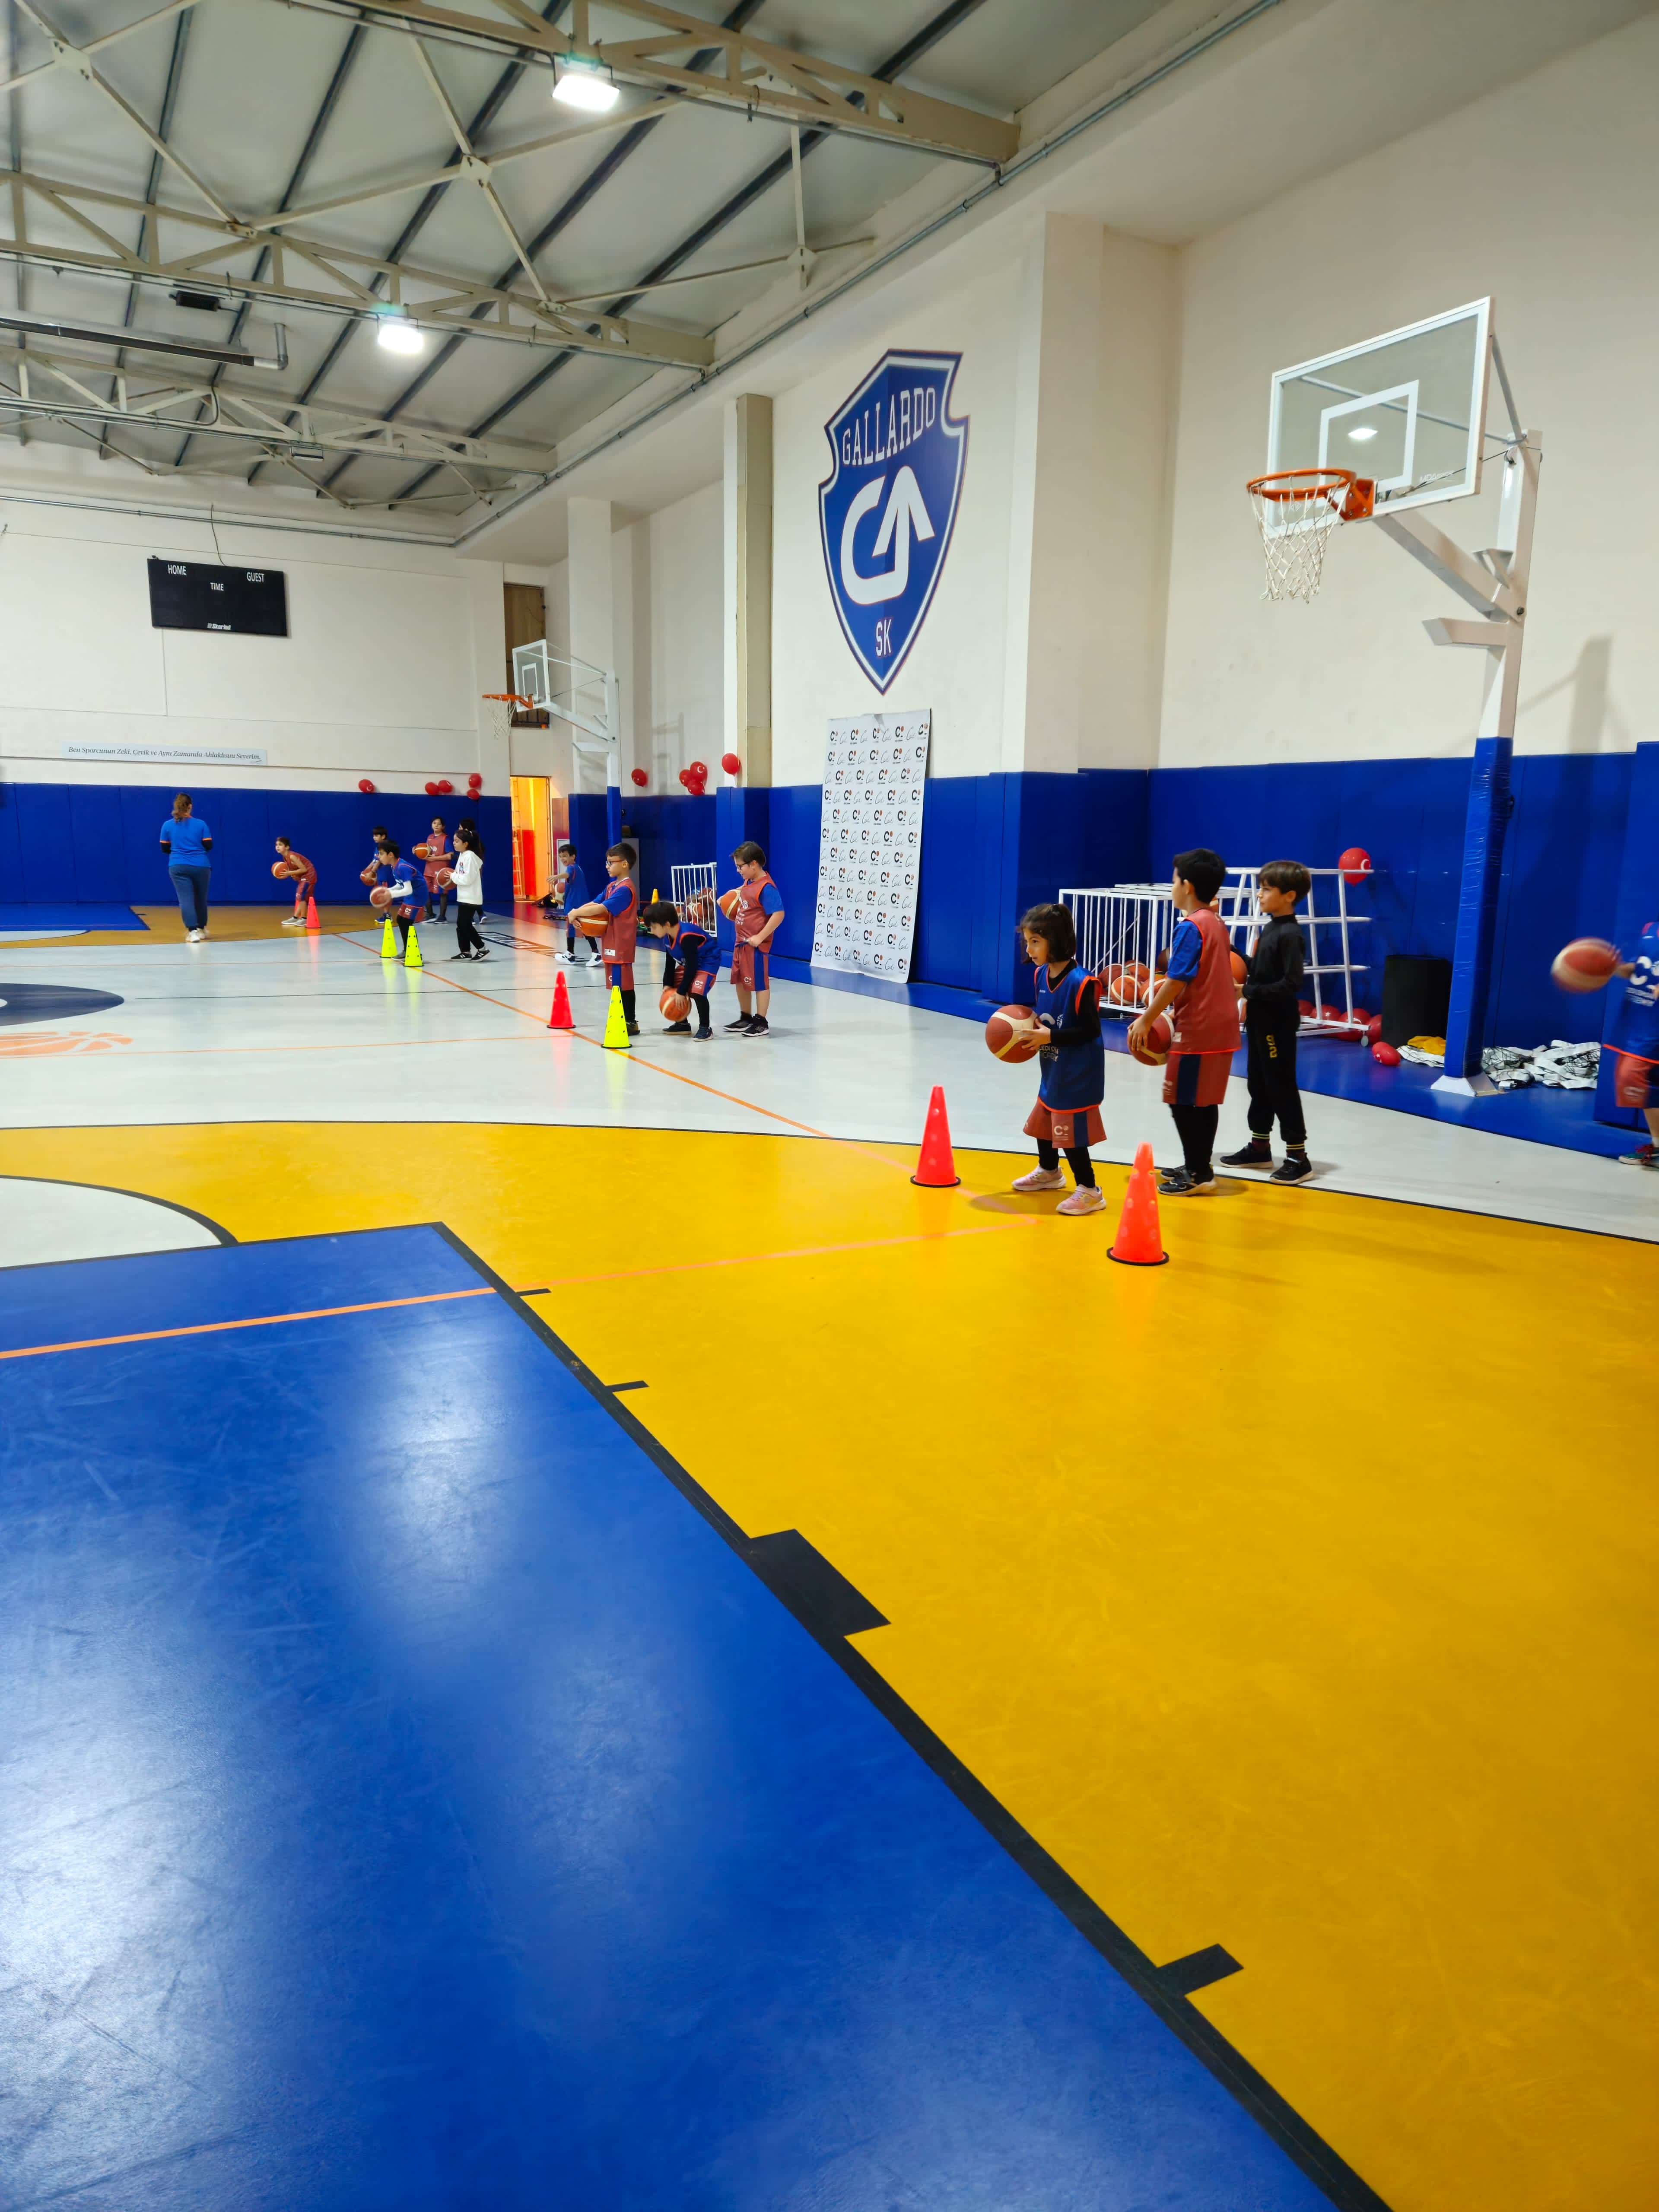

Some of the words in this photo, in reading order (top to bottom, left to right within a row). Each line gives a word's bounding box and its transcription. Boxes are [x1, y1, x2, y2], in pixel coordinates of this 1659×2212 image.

[842, 387, 935, 466] GALLARDO
[168, 564, 187, 575] HOME
[246, 572, 264, 583] GUEST
[210, 582, 224, 591] TIME
[876, 619, 892, 656] SK
[1054, 1125, 1063, 1135] C
